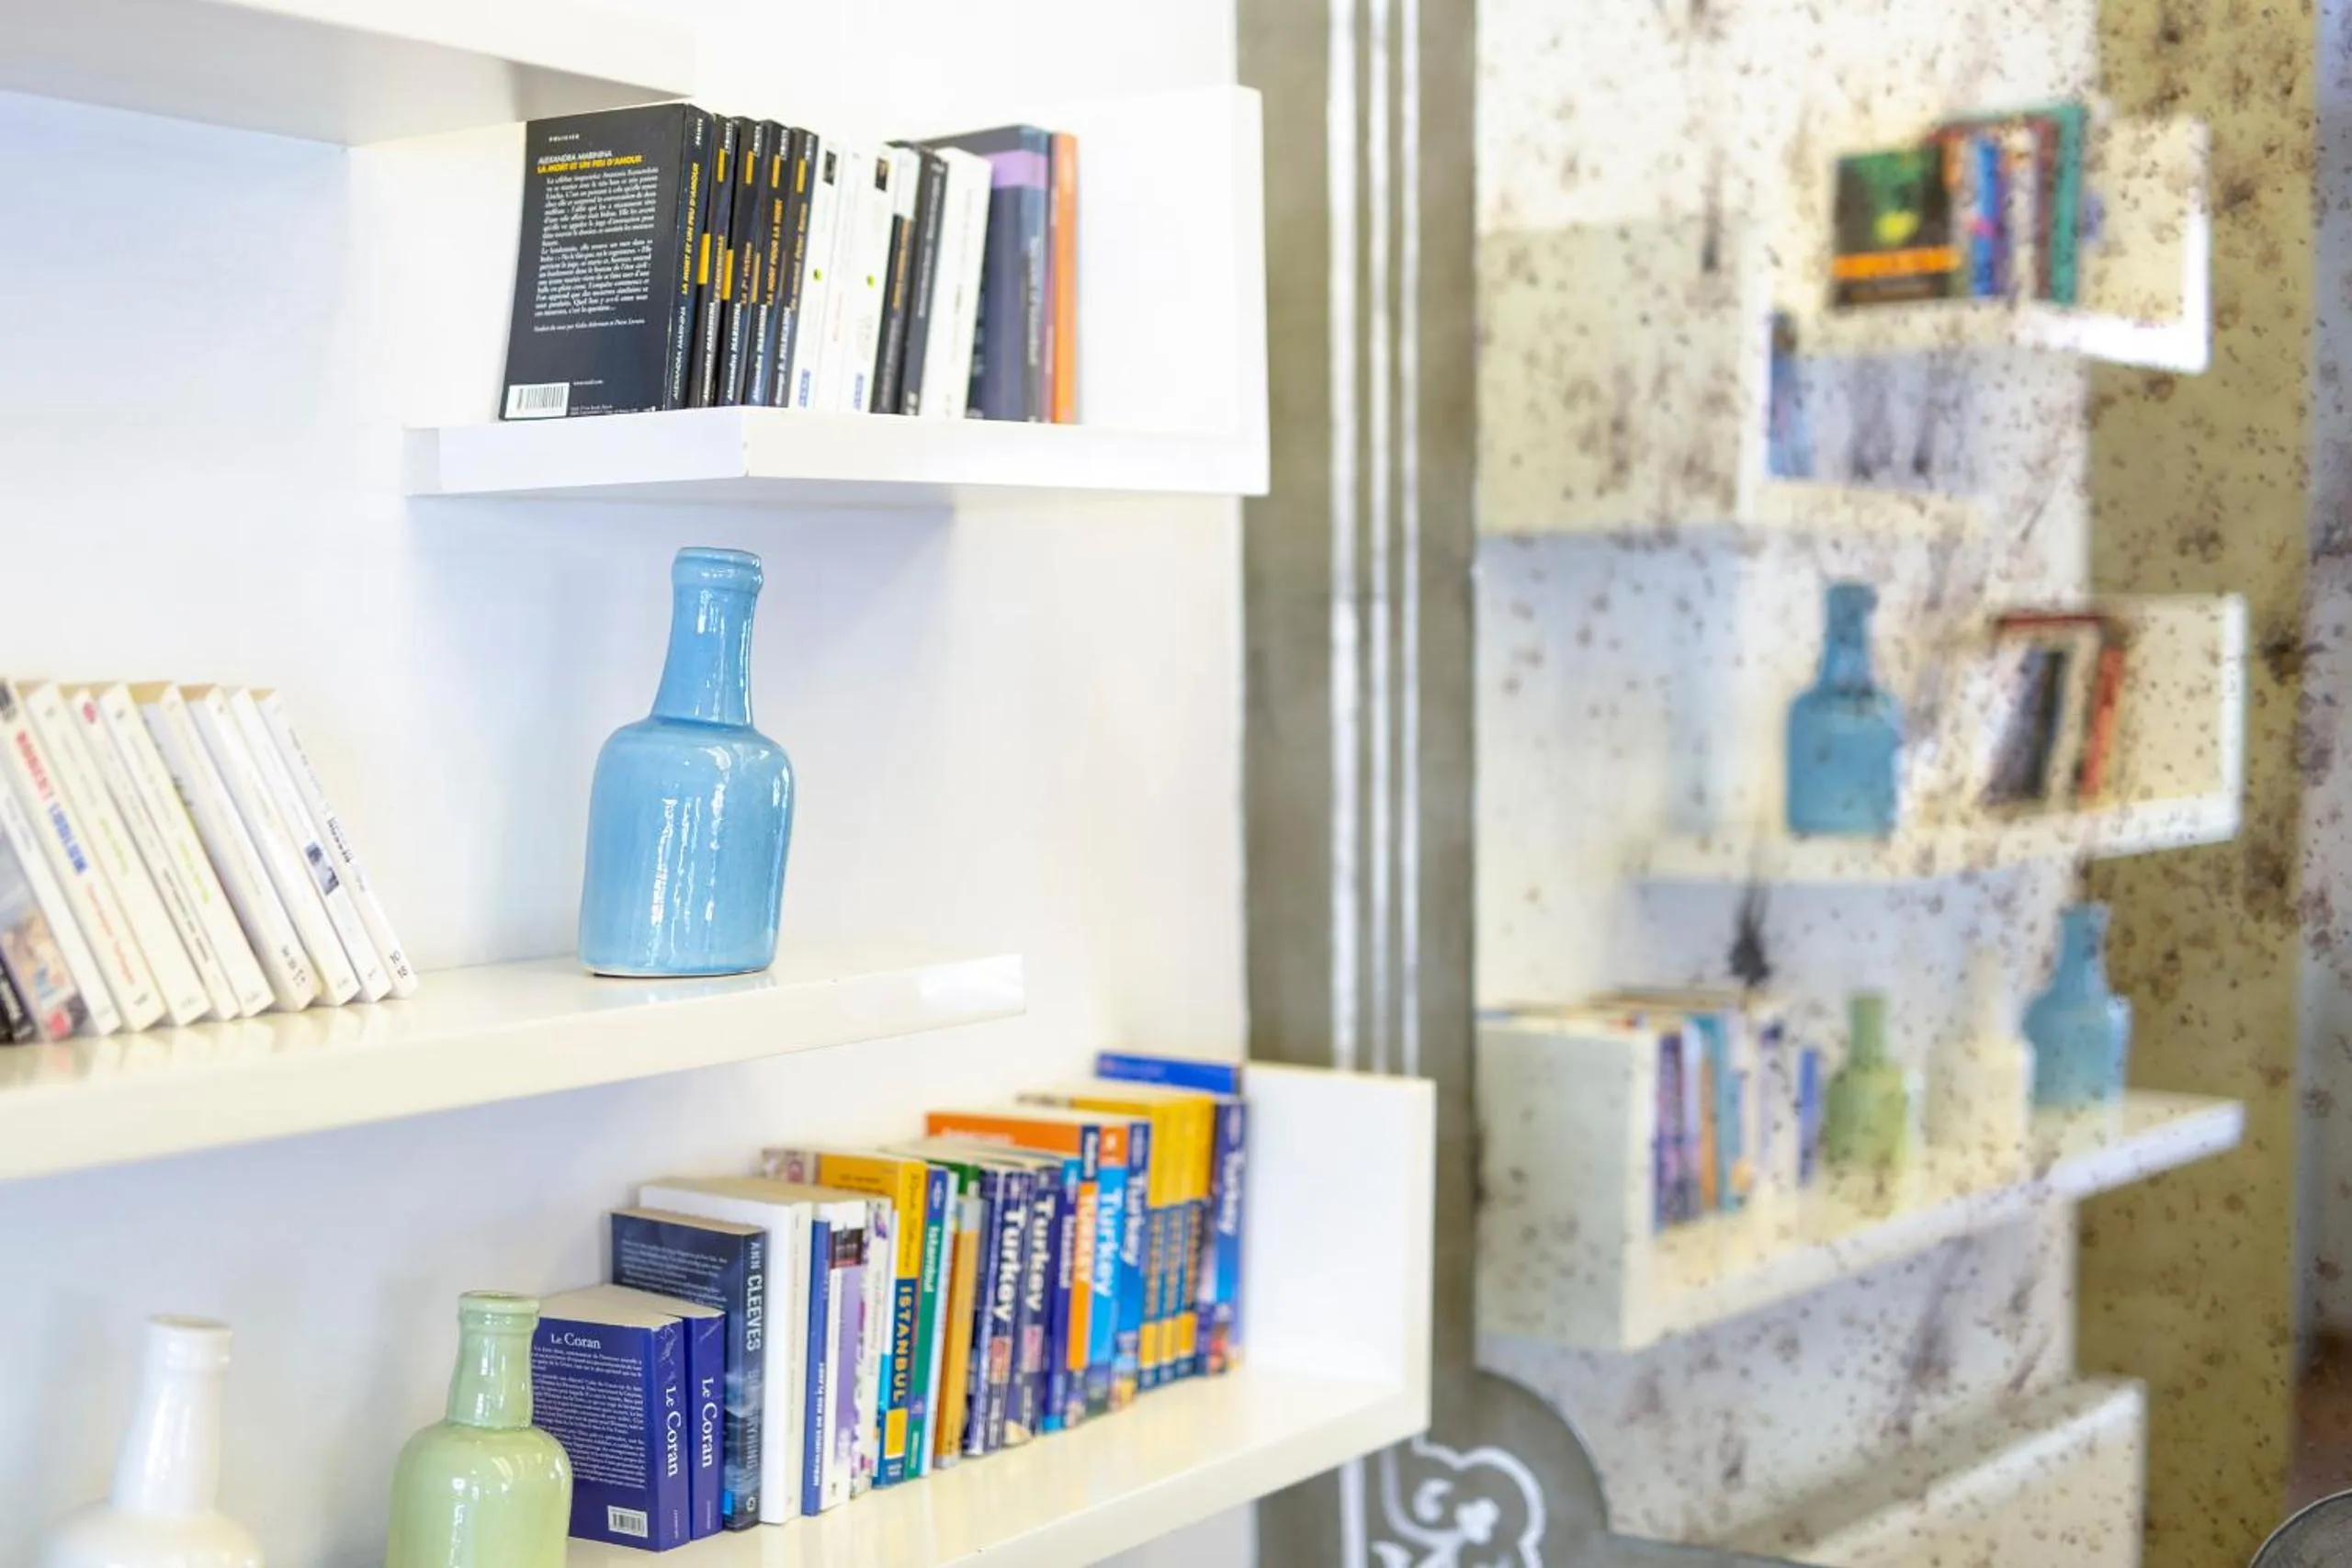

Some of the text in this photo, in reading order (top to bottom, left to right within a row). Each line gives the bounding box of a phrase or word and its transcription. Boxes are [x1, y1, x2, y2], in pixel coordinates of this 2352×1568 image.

[687, 208, 696, 226] PEU
[689, 162, 700, 207] D'AMOUR
[682, 254, 692, 282] MORT
[685, 226, 695, 243] UN
[681, 283, 690, 295] LA
[750, 1241, 762, 1270] ANN
[1025, 1194, 1056, 1312] Turkey
[1092, 1187, 1123, 1297] Turkey
[1121, 1170, 1148, 1267] Turkey
[993, 1204, 1027, 1322] Turkey
[550, 1332, 602, 1349] Le Coran
[746, 1274, 763, 1351] CLEEVES
[893, 1285, 912, 1403] ISTANBUL
[665, 1386, 682, 1477] Le Coran
[702, 1378, 718, 1468] Le Coran
